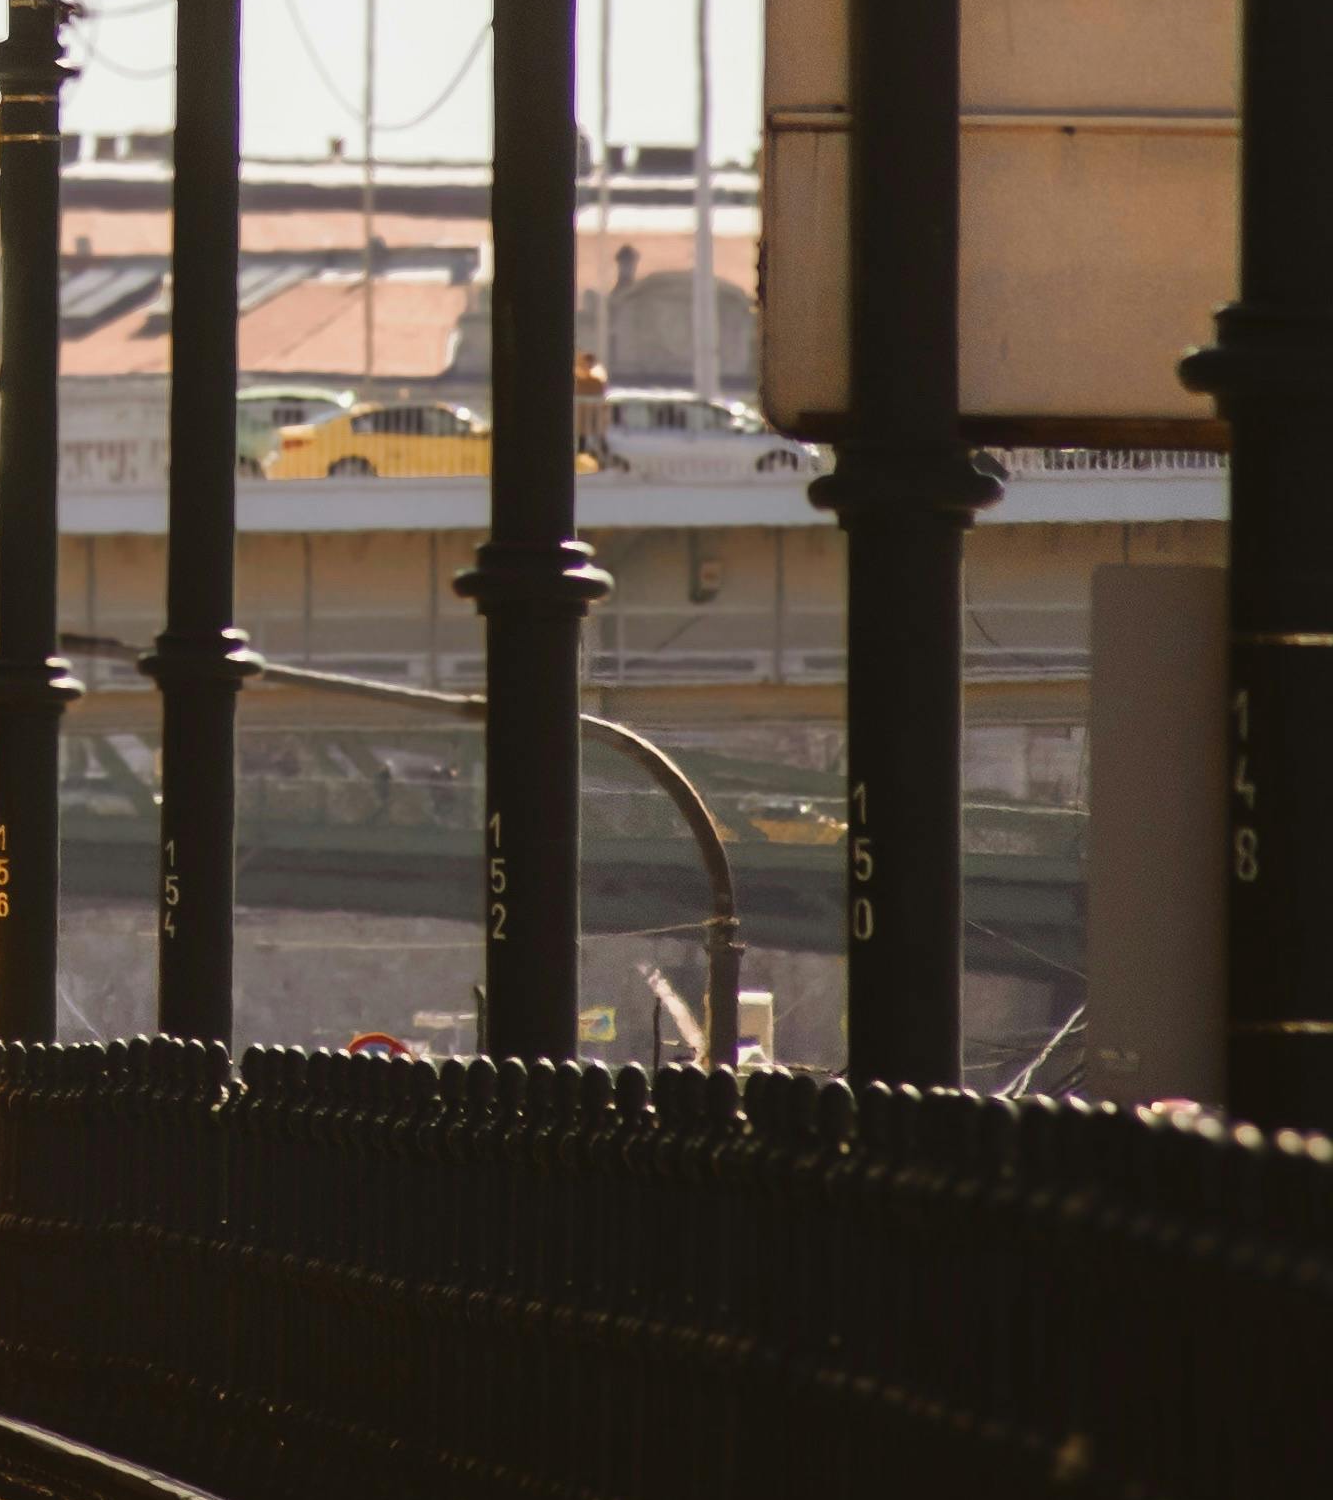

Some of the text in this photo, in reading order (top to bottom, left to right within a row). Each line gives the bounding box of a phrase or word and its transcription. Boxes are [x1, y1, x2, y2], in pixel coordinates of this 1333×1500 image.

[165, 839, 180, 939] 154
[489, 812, 507, 940] 152
[854, 782, 874, 941] 150
